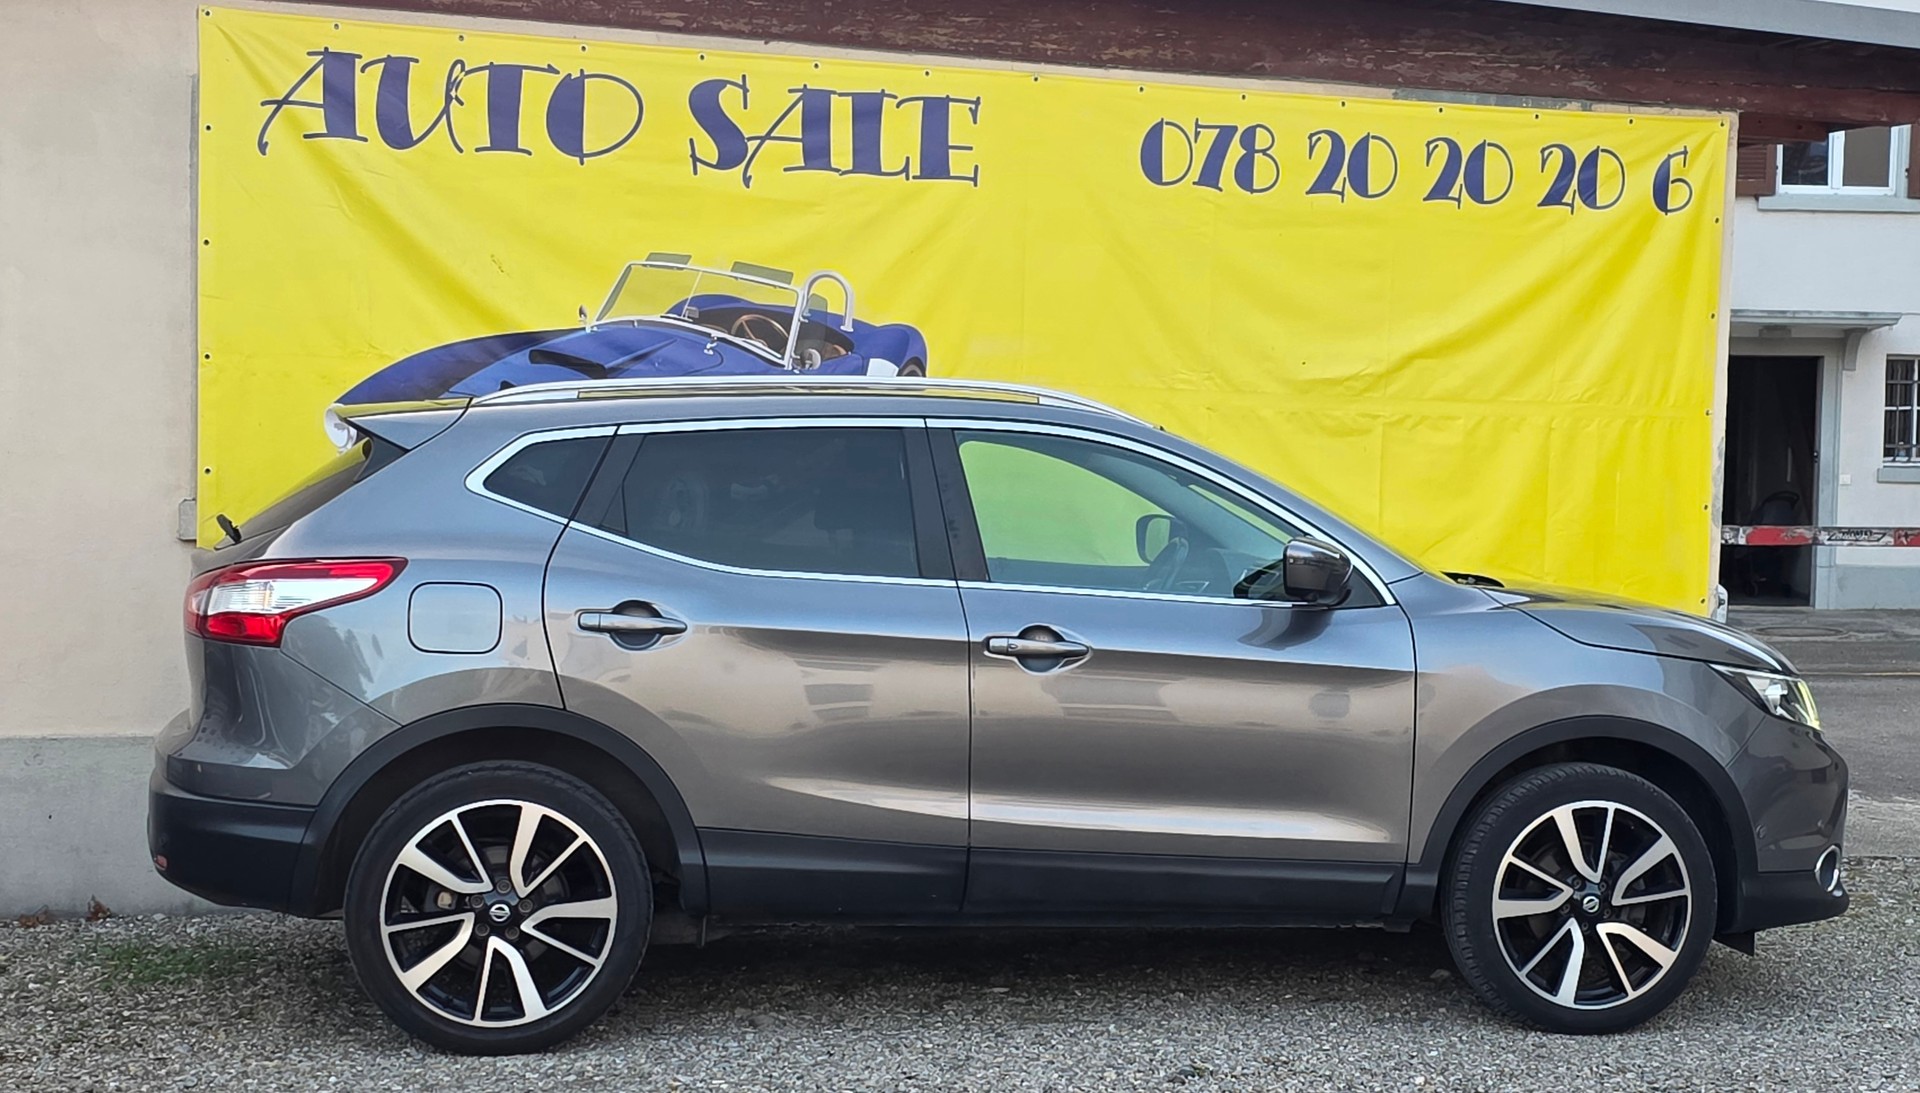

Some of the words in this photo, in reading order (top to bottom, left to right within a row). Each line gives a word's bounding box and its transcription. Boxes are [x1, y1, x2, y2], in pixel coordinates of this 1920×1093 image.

[257, 46, 644, 166] AUTO
[688, 74, 981, 189] SALE
[1140, 117, 1280, 195] 078
[1305, 129, 1398, 203] 20
[1422, 137, 1514, 210] 20
[1537, 143, 1626, 215] 20
[1652, 145, 1693, 216] 6
